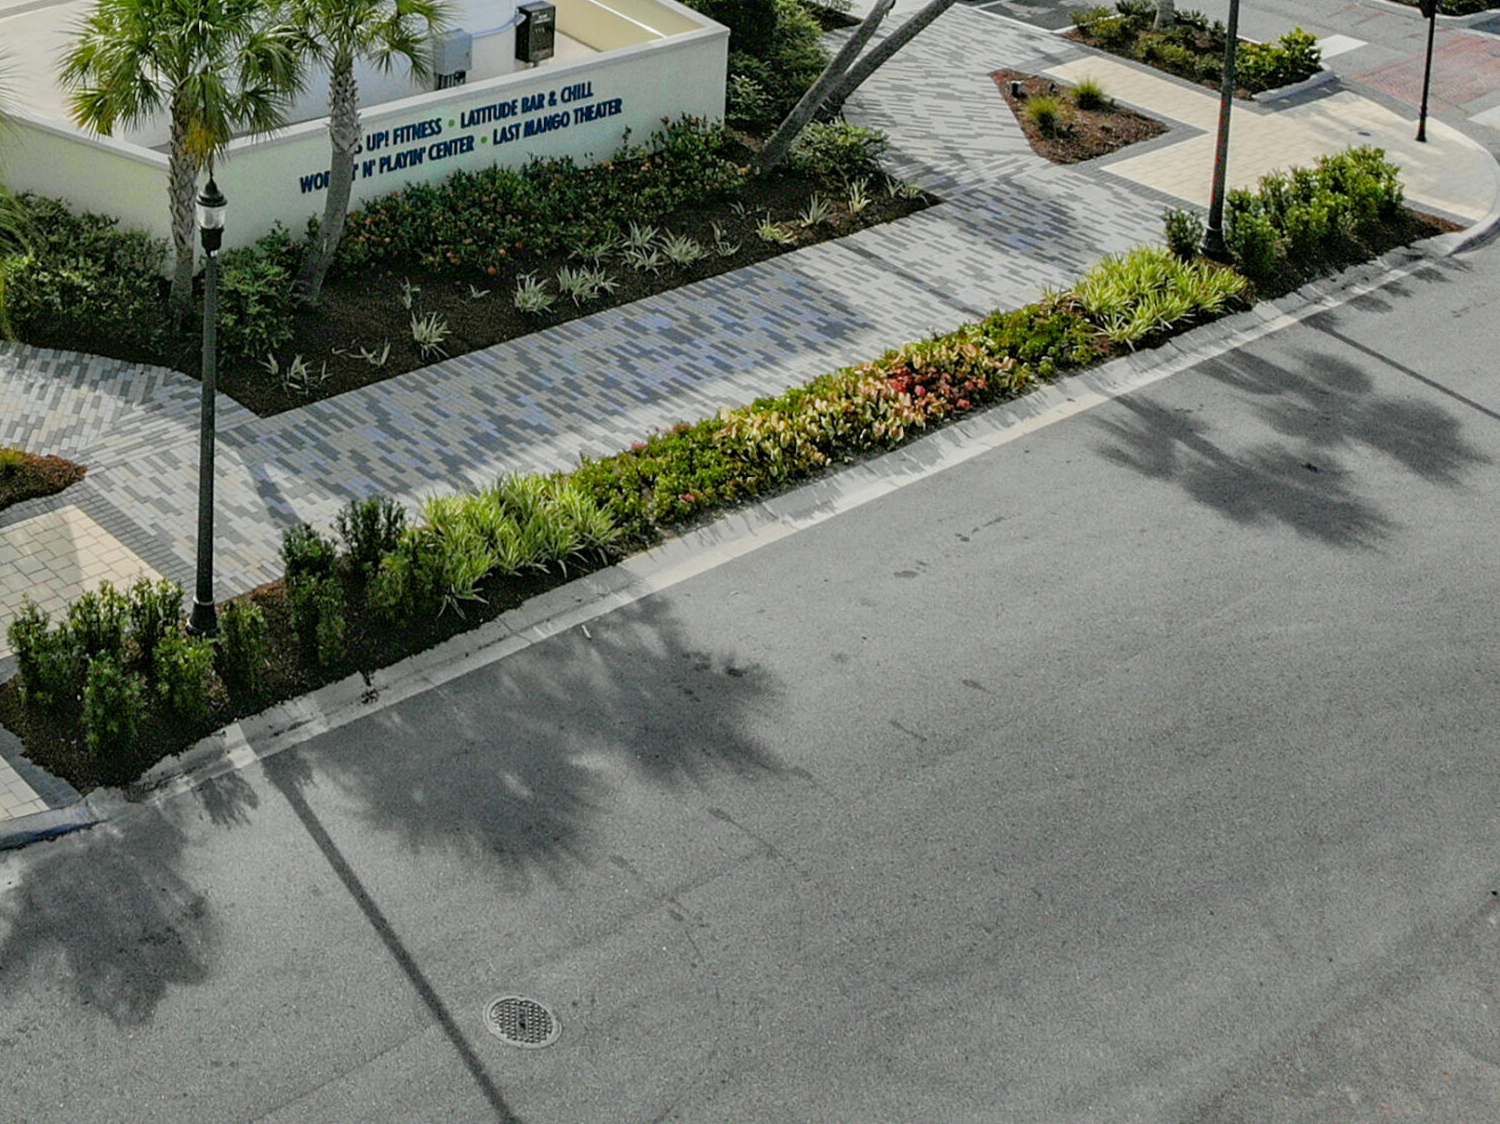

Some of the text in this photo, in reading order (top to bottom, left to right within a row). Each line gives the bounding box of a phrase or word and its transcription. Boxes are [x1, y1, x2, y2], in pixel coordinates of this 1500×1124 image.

[367, 130, 389, 152] UP!
[393, 118, 442, 145] FITNESS
[461, 99, 518, 128] LATITUDE
[521, 93, 545, 113] BAR
[548, 91, 557, 107] &
[561, 81, 594, 103] CHILL
[379, 146, 426, 174] PLAYIN'
[428, 135, 475, 161] CENTER
[493, 122, 521, 145] LAST
[524, 111, 570, 138] MANGO
[573, 98, 623, 125] THEATER
